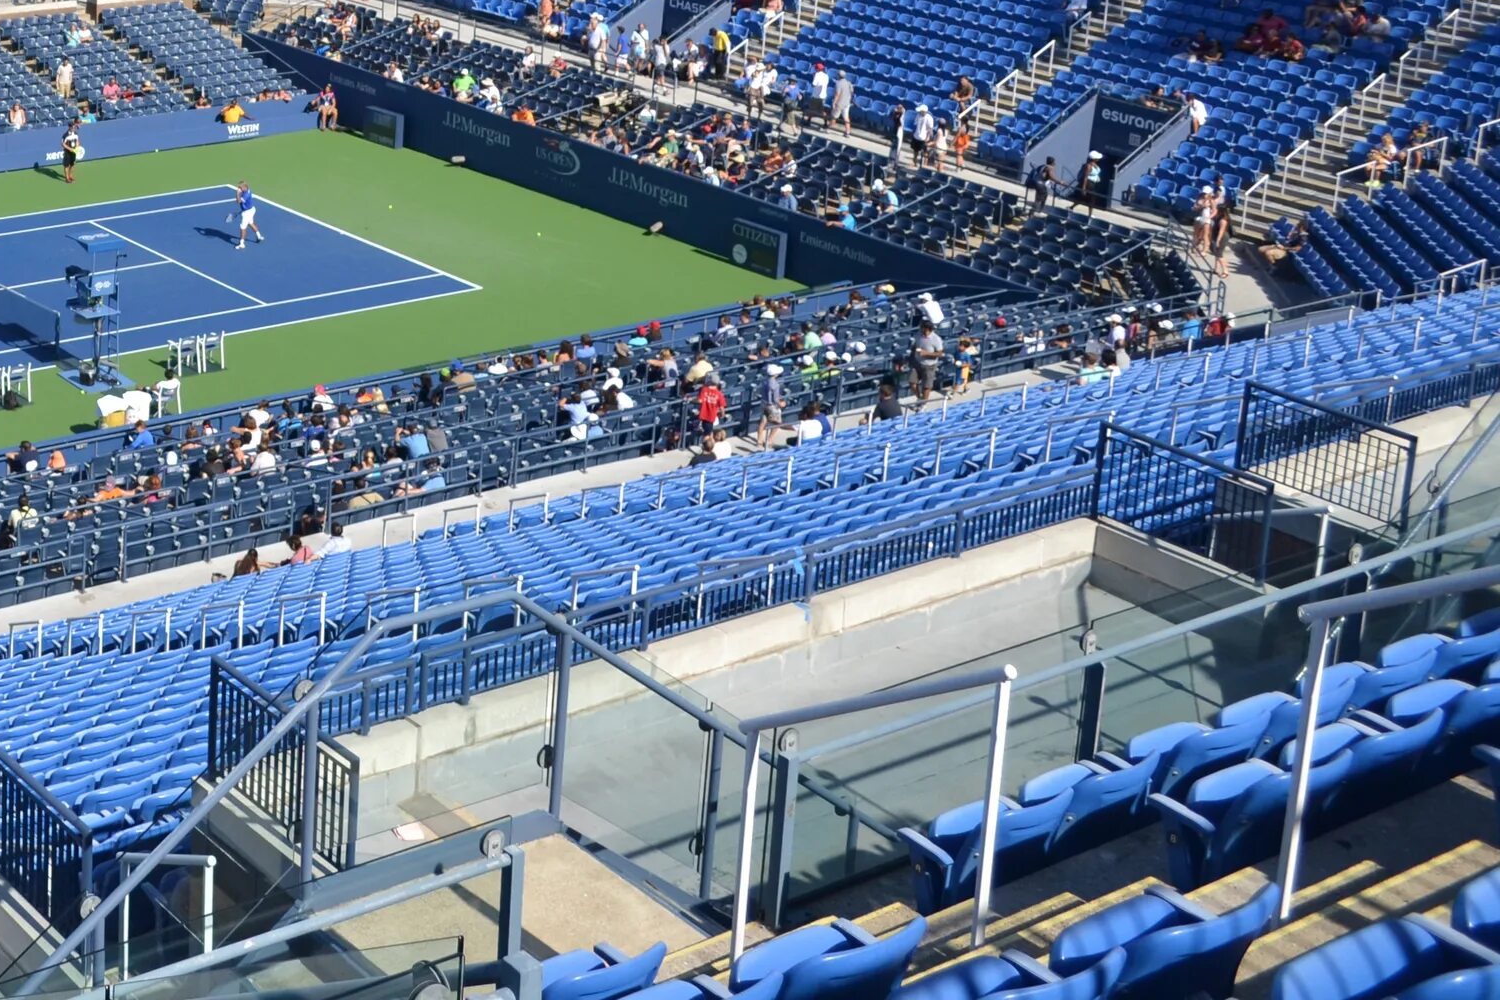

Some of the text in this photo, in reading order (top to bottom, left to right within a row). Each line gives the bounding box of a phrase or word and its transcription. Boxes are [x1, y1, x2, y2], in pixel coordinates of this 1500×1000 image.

[227, 123, 260, 135] WESTIN
[1101, 108, 1167, 133] esuranc
[45, 150, 65, 160] xero
[732, 223, 778, 248] CITIZEN
[800, 231, 876, 267] Emirates Airline
